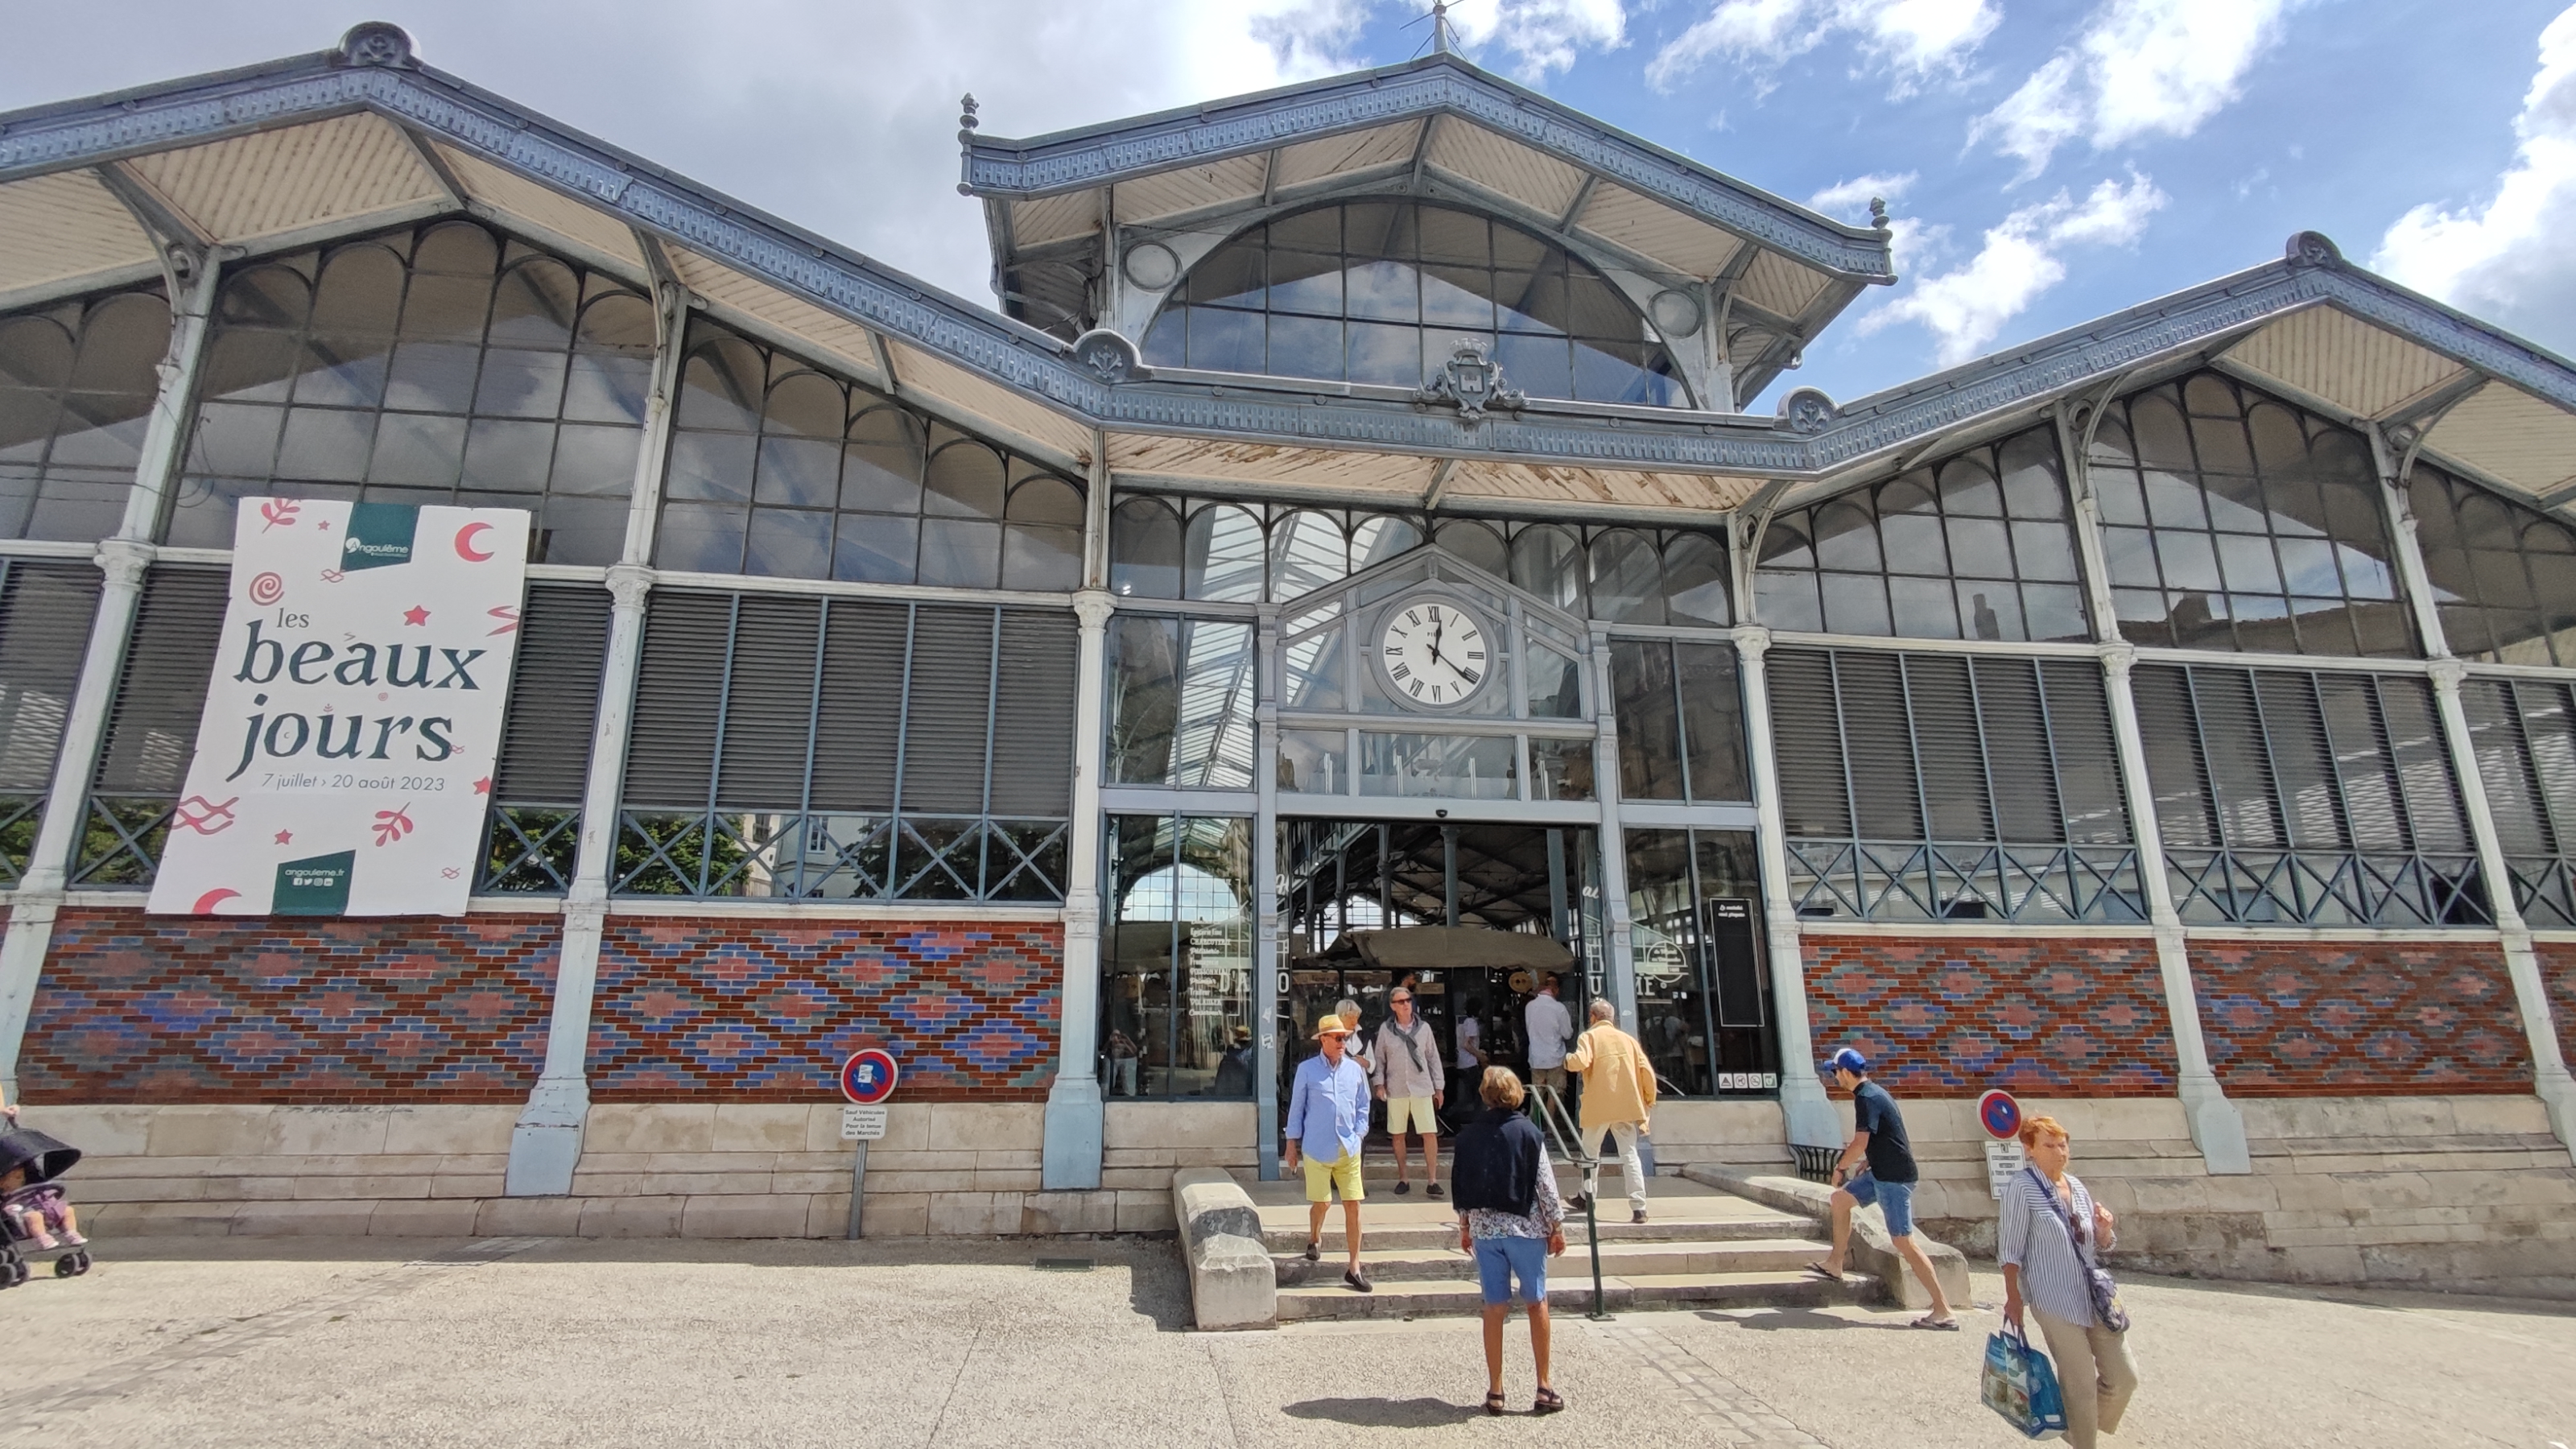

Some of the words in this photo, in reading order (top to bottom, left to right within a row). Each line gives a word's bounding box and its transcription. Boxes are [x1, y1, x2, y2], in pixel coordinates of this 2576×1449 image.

[277, 608, 310, 628] les
[233, 619, 488, 690] beaux
[225, 693, 453, 782] jours
[262, 773, 275, 787] 7
[276, 773, 317, 791] juillet
[331, 774, 353, 788] 20
[358, 776, 395, 789] août
[400, 776, 445, 791] 2023
